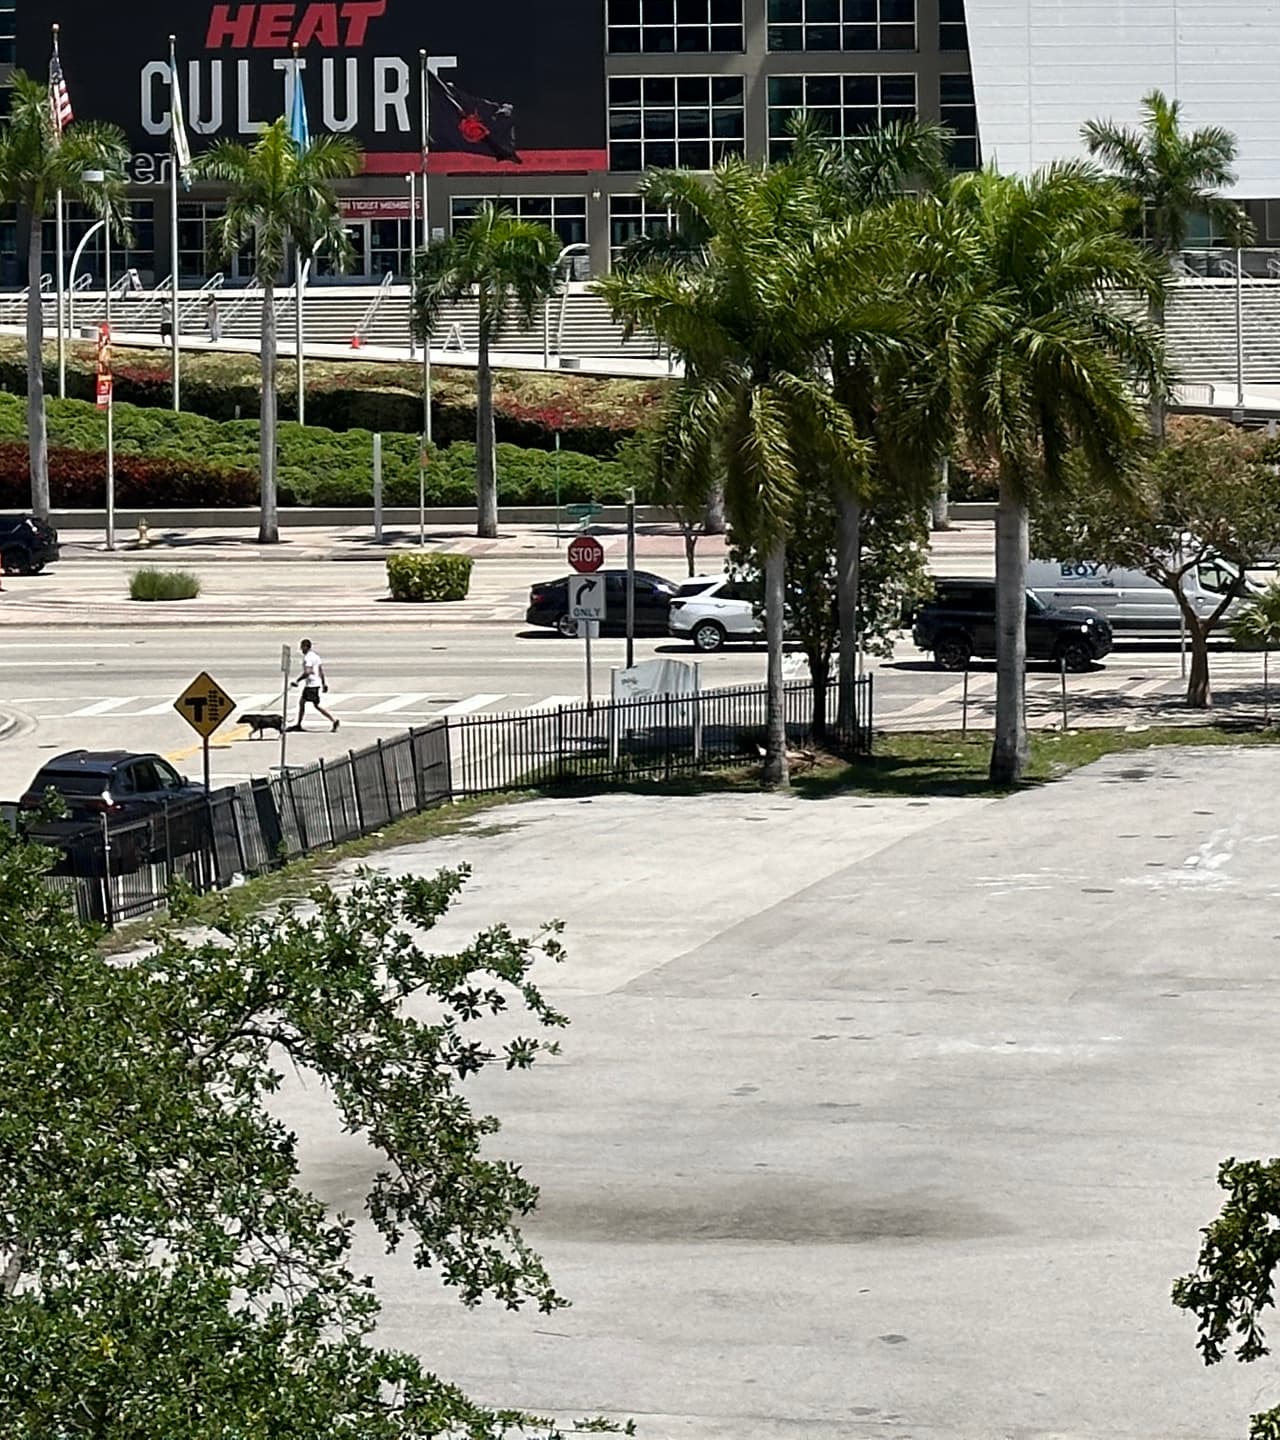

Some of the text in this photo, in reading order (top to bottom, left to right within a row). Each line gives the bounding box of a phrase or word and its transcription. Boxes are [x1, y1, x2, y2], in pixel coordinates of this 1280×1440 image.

[140, 56, 458, 136] CULTUR
[570, 547, 601, 563] STOP
[573, 607, 601, 617] ONLY
